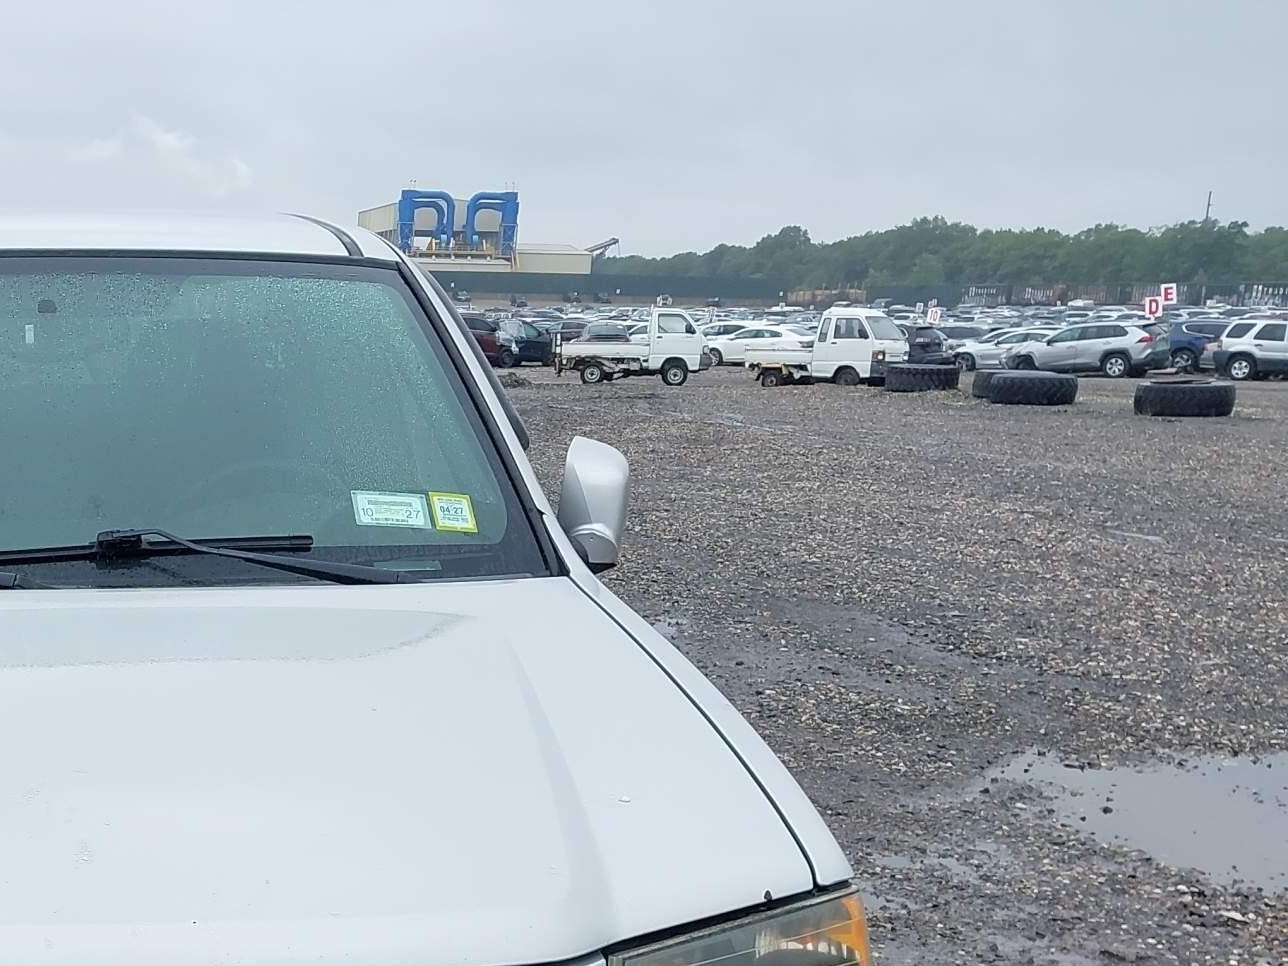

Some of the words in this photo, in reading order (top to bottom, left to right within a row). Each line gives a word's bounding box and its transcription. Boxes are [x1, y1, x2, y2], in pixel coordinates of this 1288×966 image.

[1163, 286, 1174, 302] E
[1148, 299, 1159, 315] D
[361, 507, 374, 517] 10
[405, 509, 421, 519] 27
